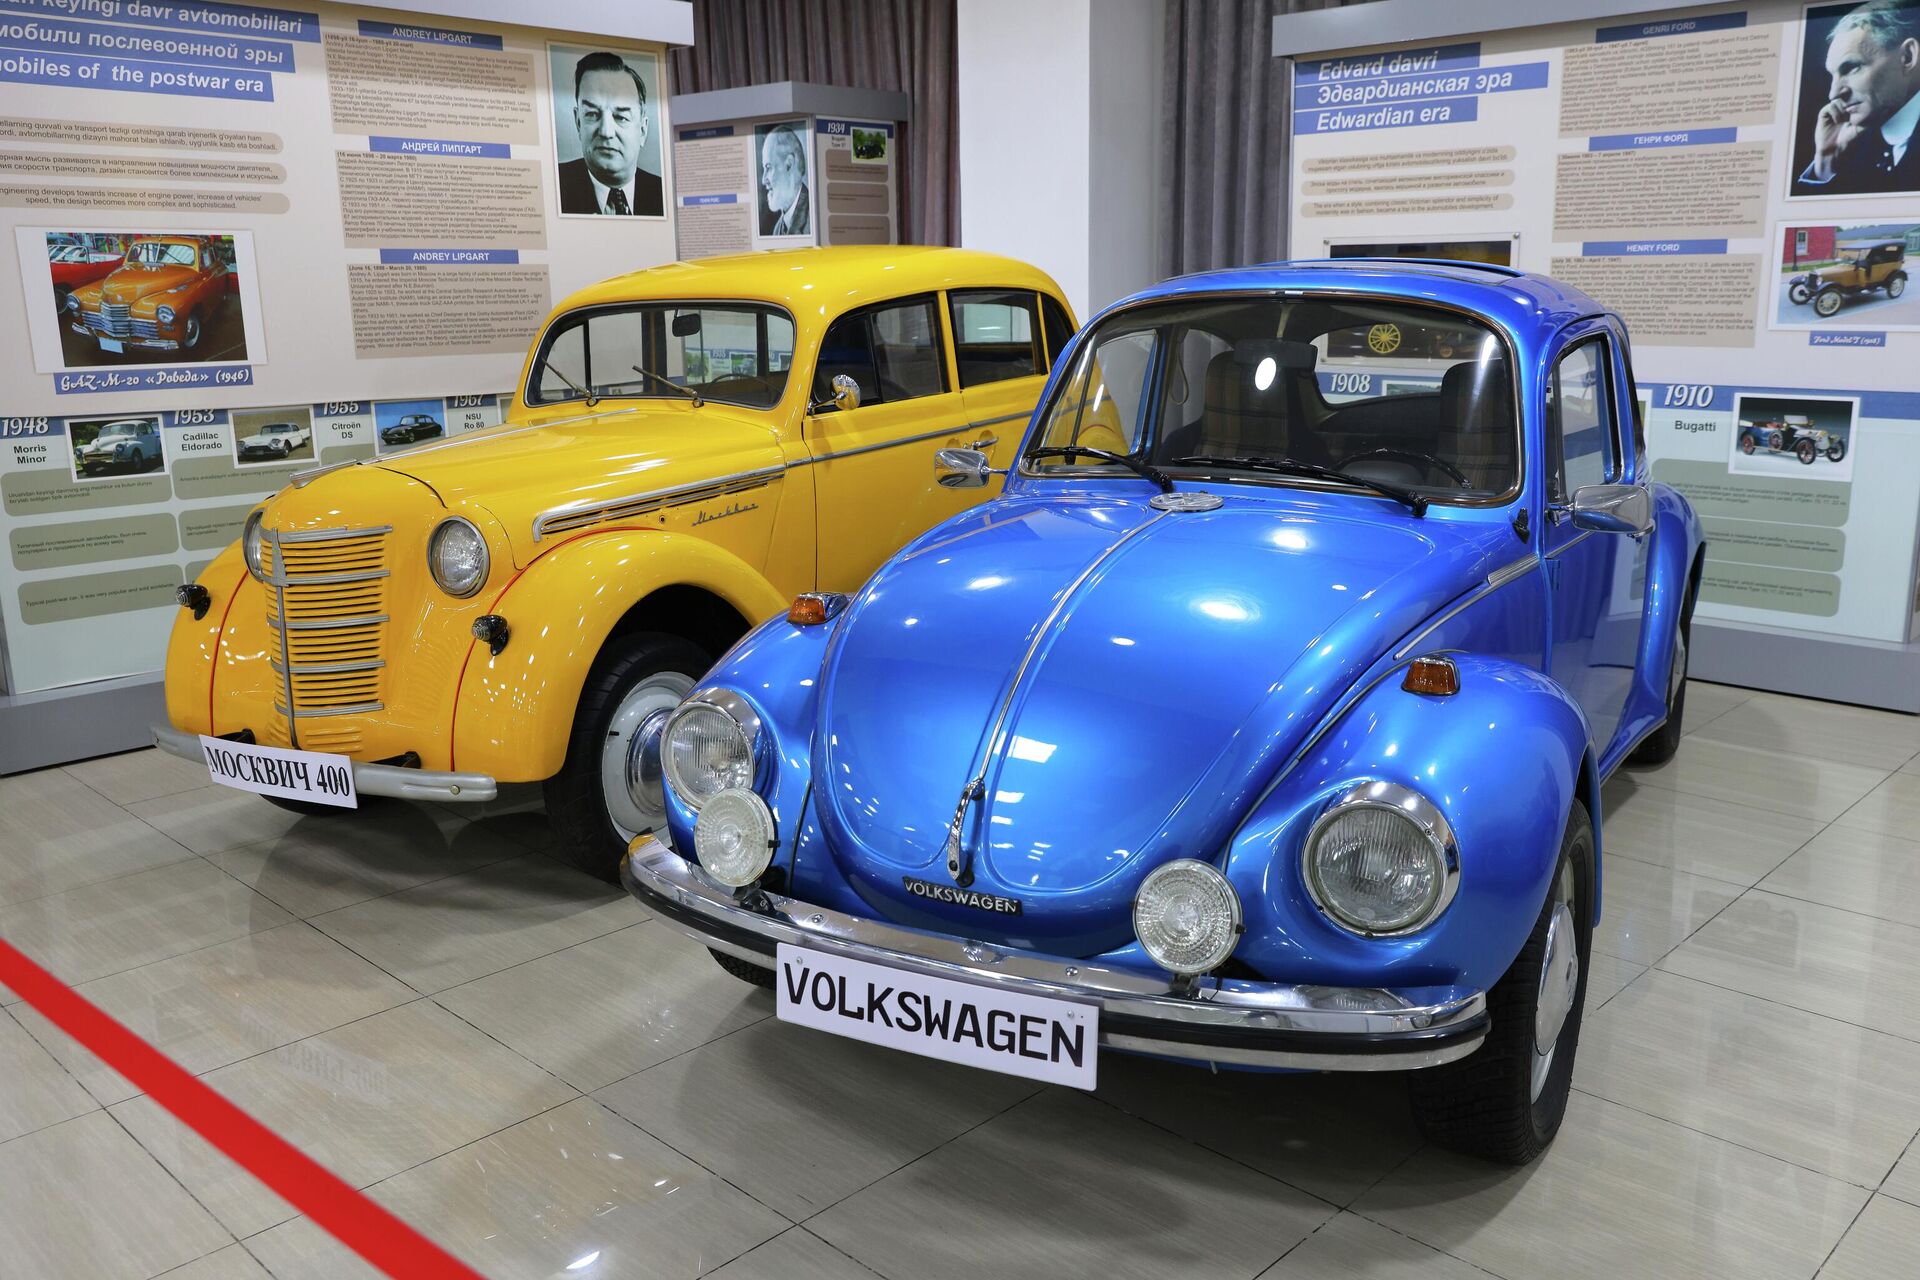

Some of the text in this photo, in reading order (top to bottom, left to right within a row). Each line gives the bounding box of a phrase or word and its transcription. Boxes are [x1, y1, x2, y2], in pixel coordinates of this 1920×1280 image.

[127, 0, 173, 19] davr
[179, 8, 303, 34] avtomobillari
[1643, 21, 1696, 35] GENRI FORD
[392, 27, 473, 44] ANDREY LIPGART
[88, 33, 238, 59] послевоенной
[244, 48, 284, 65] эры
[1318, 51, 1438, 81] Edvard davri
[0, 57, 264, 93] obiles of the postwar era
[1317, 71, 1512, 105] Эдвардианская эра
[1317, 107, 1451, 131] Edwardian era
[1634, 133, 1688, 144] ГЕНРИ ФОРД
[402, 141, 482, 155] АНДРЕЙ ЛИПГАРТ
[0, 188, 39, 196] ngineering
[1627, 243, 1680, 252] HENRY FORD
[413, 252, 490, 261] ANDREY LIPGART
[215, 369, 250, 383] (1946)
[1330, 373, 1371, 393] 1908
[1664, 384, 1713, 408] 1910
[322, 401, 360, 415] 1955
[173, 408, 216, 425] 1953
[1, 416, 49, 436] 1948
[332, 422, 361, 430] Citroën
[476, 420, 485, 428] 80
[1674, 420, 1717, 432] Bugatti
[182, 432, 219, 442] Cadillac
[341, 431, 354, 439] DS
[13, 444, 47, 454] Morris
[181, 441, 222, 452] Eldorado
[17, 455, 47, 464] Minor
[204, 745, 350, 797] МОСКВИЧ 400
[905, 880, 1017, 913] VOLKSWAGEN
[784, 962, 1084, 1068] VOLKSWAGEN
